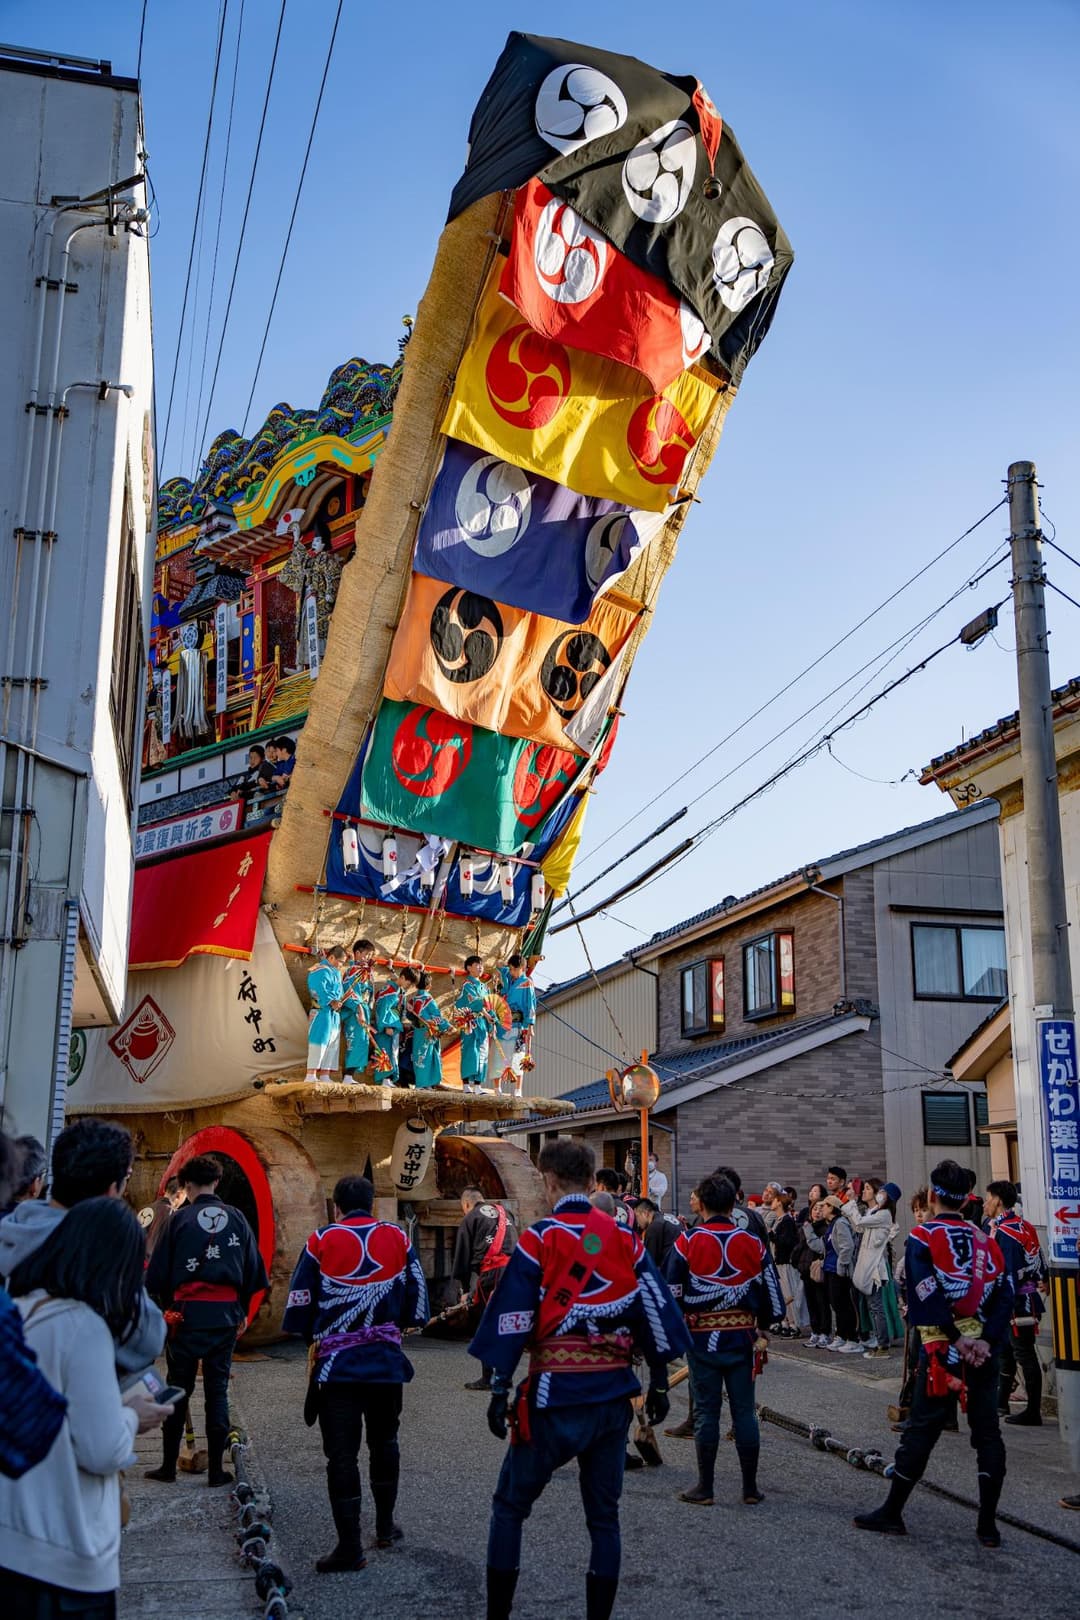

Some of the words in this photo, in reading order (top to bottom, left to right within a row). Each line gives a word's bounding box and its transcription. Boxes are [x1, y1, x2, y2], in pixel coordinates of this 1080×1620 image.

[237, 970, 276, 1053] 府中町
[1045, 1028, 1080, 1184] せがわ薬局
[400, 1143, 426, 1187] 府中町
